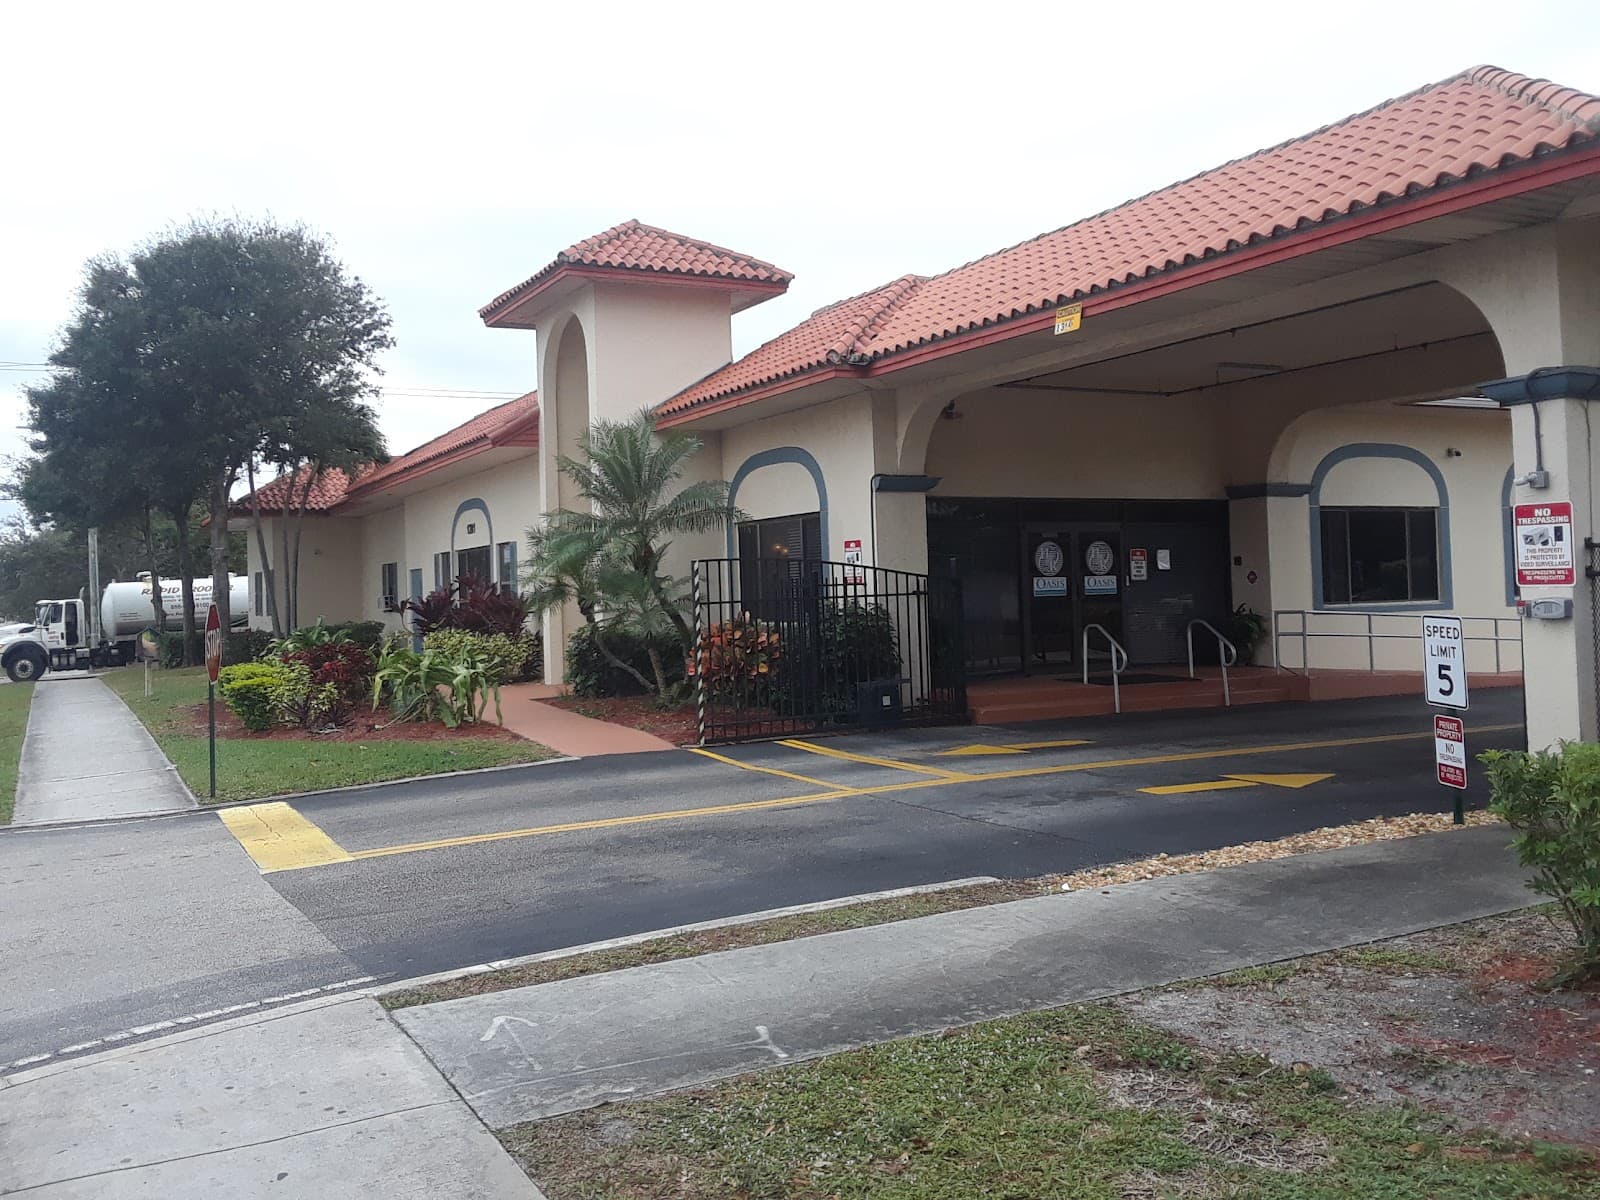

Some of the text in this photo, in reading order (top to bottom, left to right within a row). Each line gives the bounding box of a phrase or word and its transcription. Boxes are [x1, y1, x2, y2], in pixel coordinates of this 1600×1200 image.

[1534, 508, 1551, 516] NO
[1518, 516, 1569, 524] TRESPASSING
[142, 586, 180, 595] RPID
[1425, 624, 1460, 640] SPEED
[206, 628, 221, 660] STOP
[1430, 644, 1457, 658] LIMIT
[1438, 664, 1454, 696] 5
[1438, 720, 1458, 731] PRIVATE
[1436, 728, 1461, 741] PROPERTY
[1445, 743, 1455, 754] NO
[1440, 754, 1462, 764] TRESPASSING
